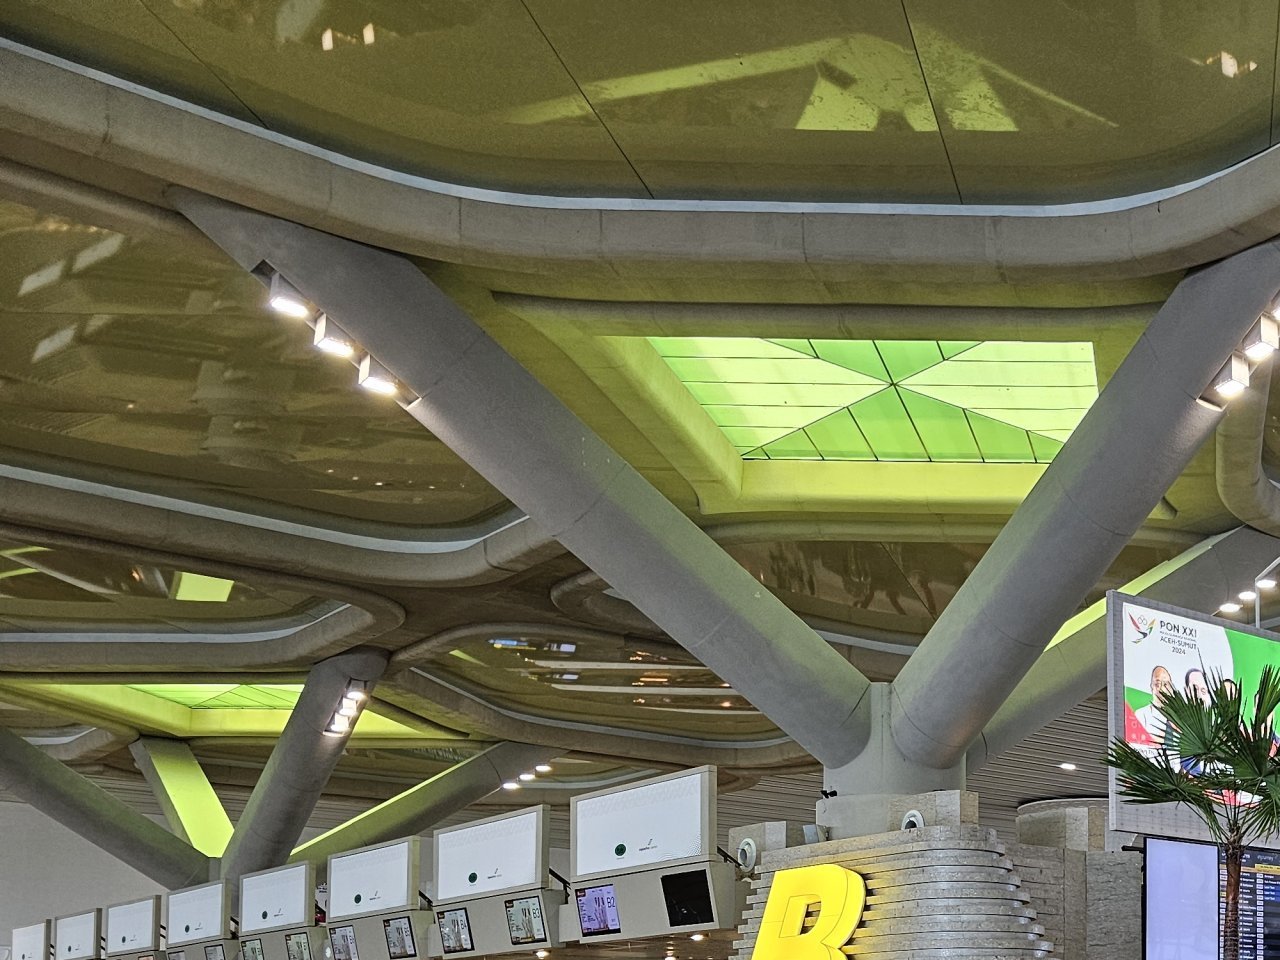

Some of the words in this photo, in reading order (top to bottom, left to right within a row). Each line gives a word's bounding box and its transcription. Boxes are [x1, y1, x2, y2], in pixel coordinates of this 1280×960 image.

[1160, 620, 1180, 634] PON
[1181, 625, 1197, 638] XXI
[1160, 636, 1197, 650] ACEH-SUMUT
[1171, 646, 1186, 655] 2024
[606, 896, 616, 908] B2
[532, 907, 541, 919] B3
